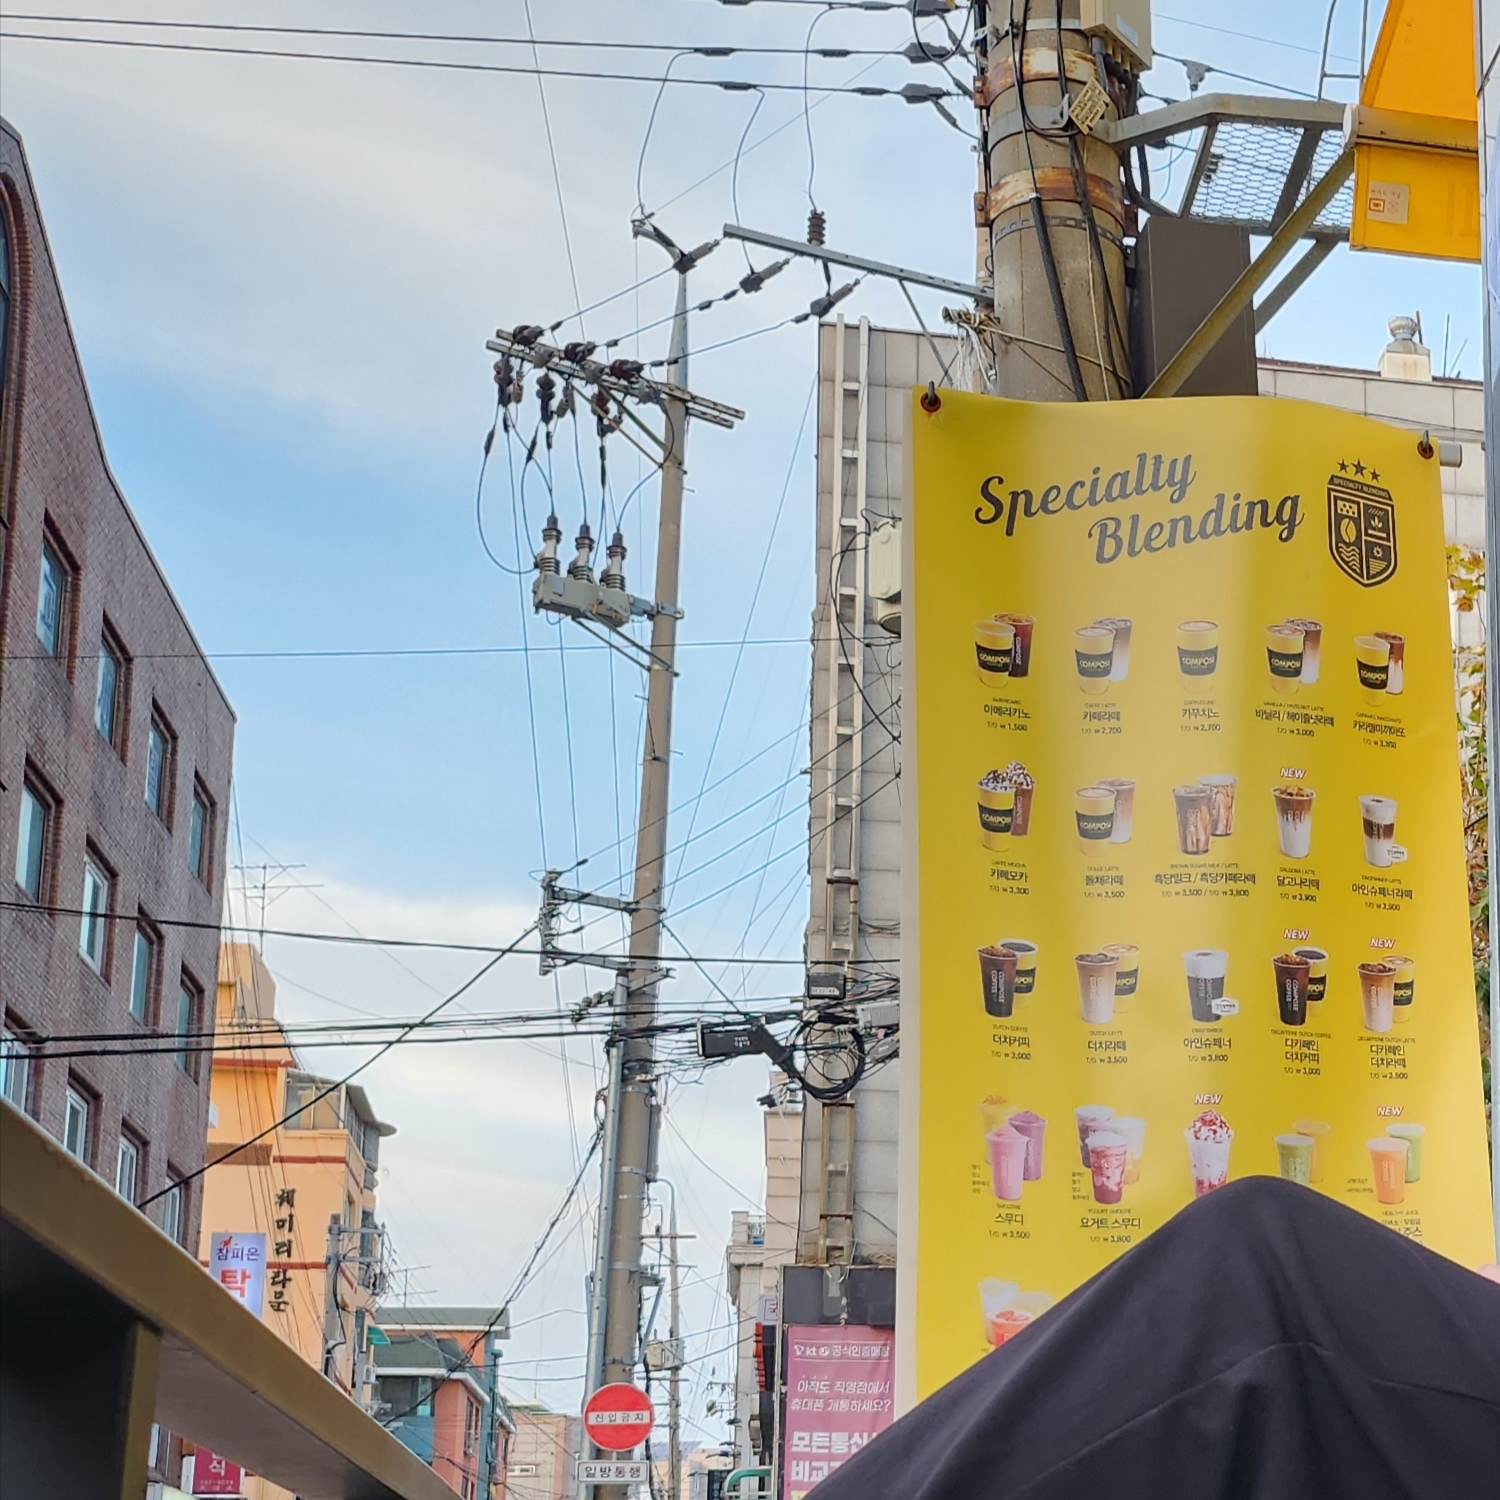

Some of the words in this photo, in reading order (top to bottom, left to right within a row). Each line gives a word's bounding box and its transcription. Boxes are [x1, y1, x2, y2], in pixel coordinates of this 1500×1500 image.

[974, 452, 1197, 537] Specialty
[1088, 493, 1305, 564] Blending
[1280, 767, 1307, 779] NEW
[1284, 929, 1310, 941] NEW
[1370, 938, 1395, 949] NEW
[1194, 1094, 1222, 1105] NEW
[1377, 1106, 1404, 1117] NEW
[994, 1212, 1024, 1225] 스무디
[1111, 1217, 1141, 1229] 스무디
[797, 1380, 830, 1394] 아직도
[834, 1381, 889, 1395] 직영점에서
[791, 1399, 824, 1412] 휴대폰
[594, 1413, 645, 1423] 진입금지
[584, 1465, 642, 1479] 일방통행
